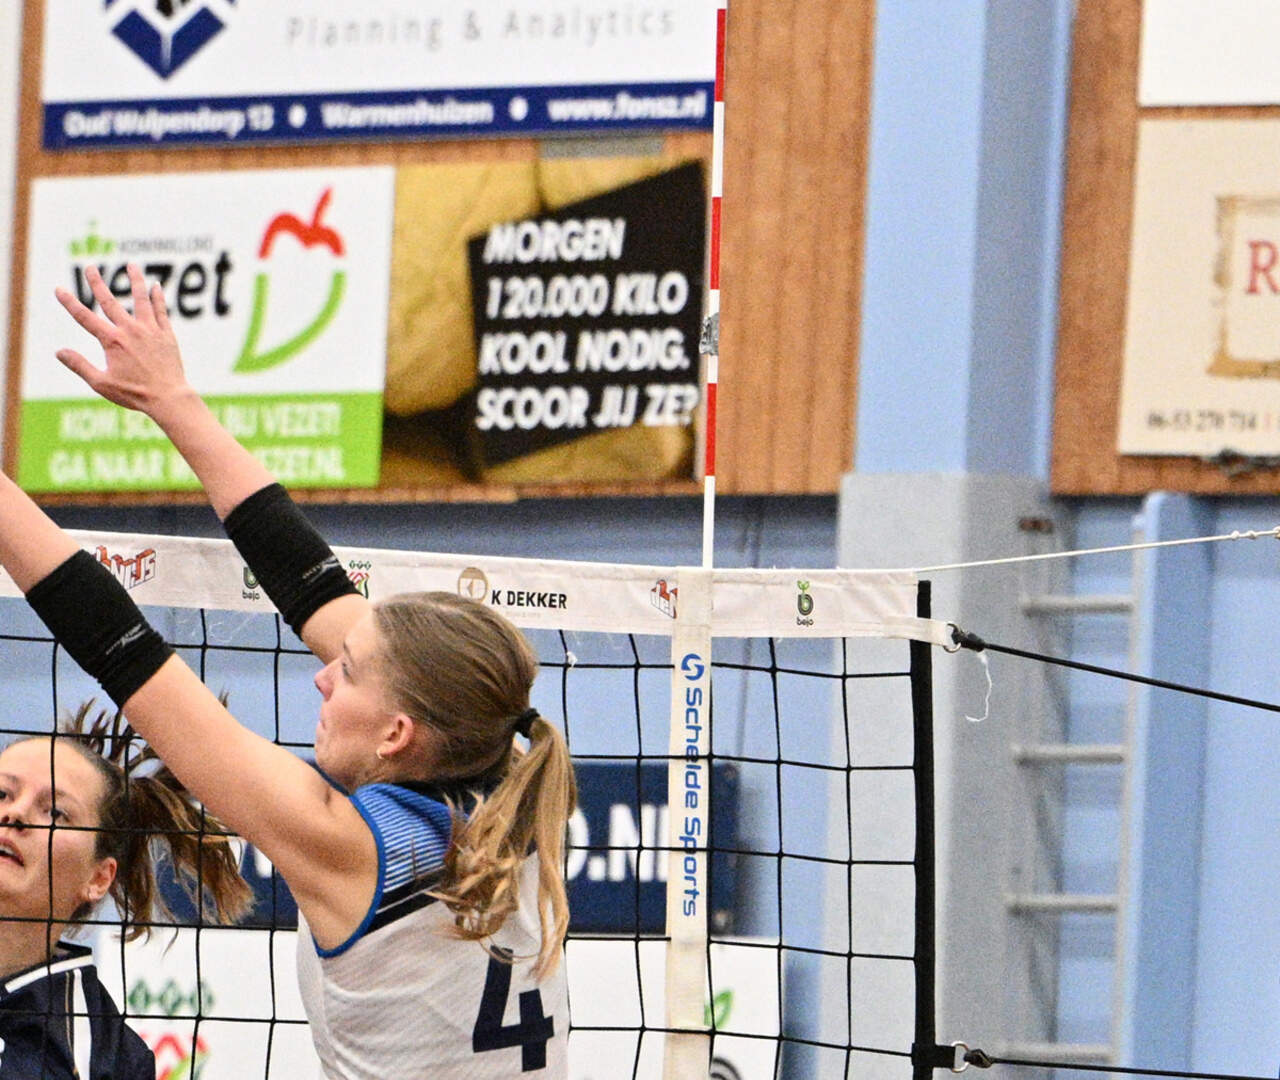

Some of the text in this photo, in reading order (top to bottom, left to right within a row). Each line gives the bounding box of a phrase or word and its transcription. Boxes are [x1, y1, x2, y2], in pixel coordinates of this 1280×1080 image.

[287, 5, 676, 52] Planning & Analytics
[64, 110, 110, 138] Oud
[112, 105, 245, 140] Wulpendorp
[246, 103, 275, 131] 13
[321, 98, 494, 130] Warmenhuizen
[483, 218, 627, 263] MORGEN
[72, 249, 234, 320] vezet
[486, 271, 689, 318] 120.000 KILO
[478, 328, 690, 374] KOOL NODIG.
[60, 409, 117, 440] KOM
[474, 383, 699, 430] SCOOR JIJ ZE?
[49, 451, 88, 485] GA
[91, 449, 164, 483] NAAR
[491, 589, 567, 608] K DEKKER
[679, 687, 702, 916] Schelde Sports
[472, 946, 554, 1073] 4
